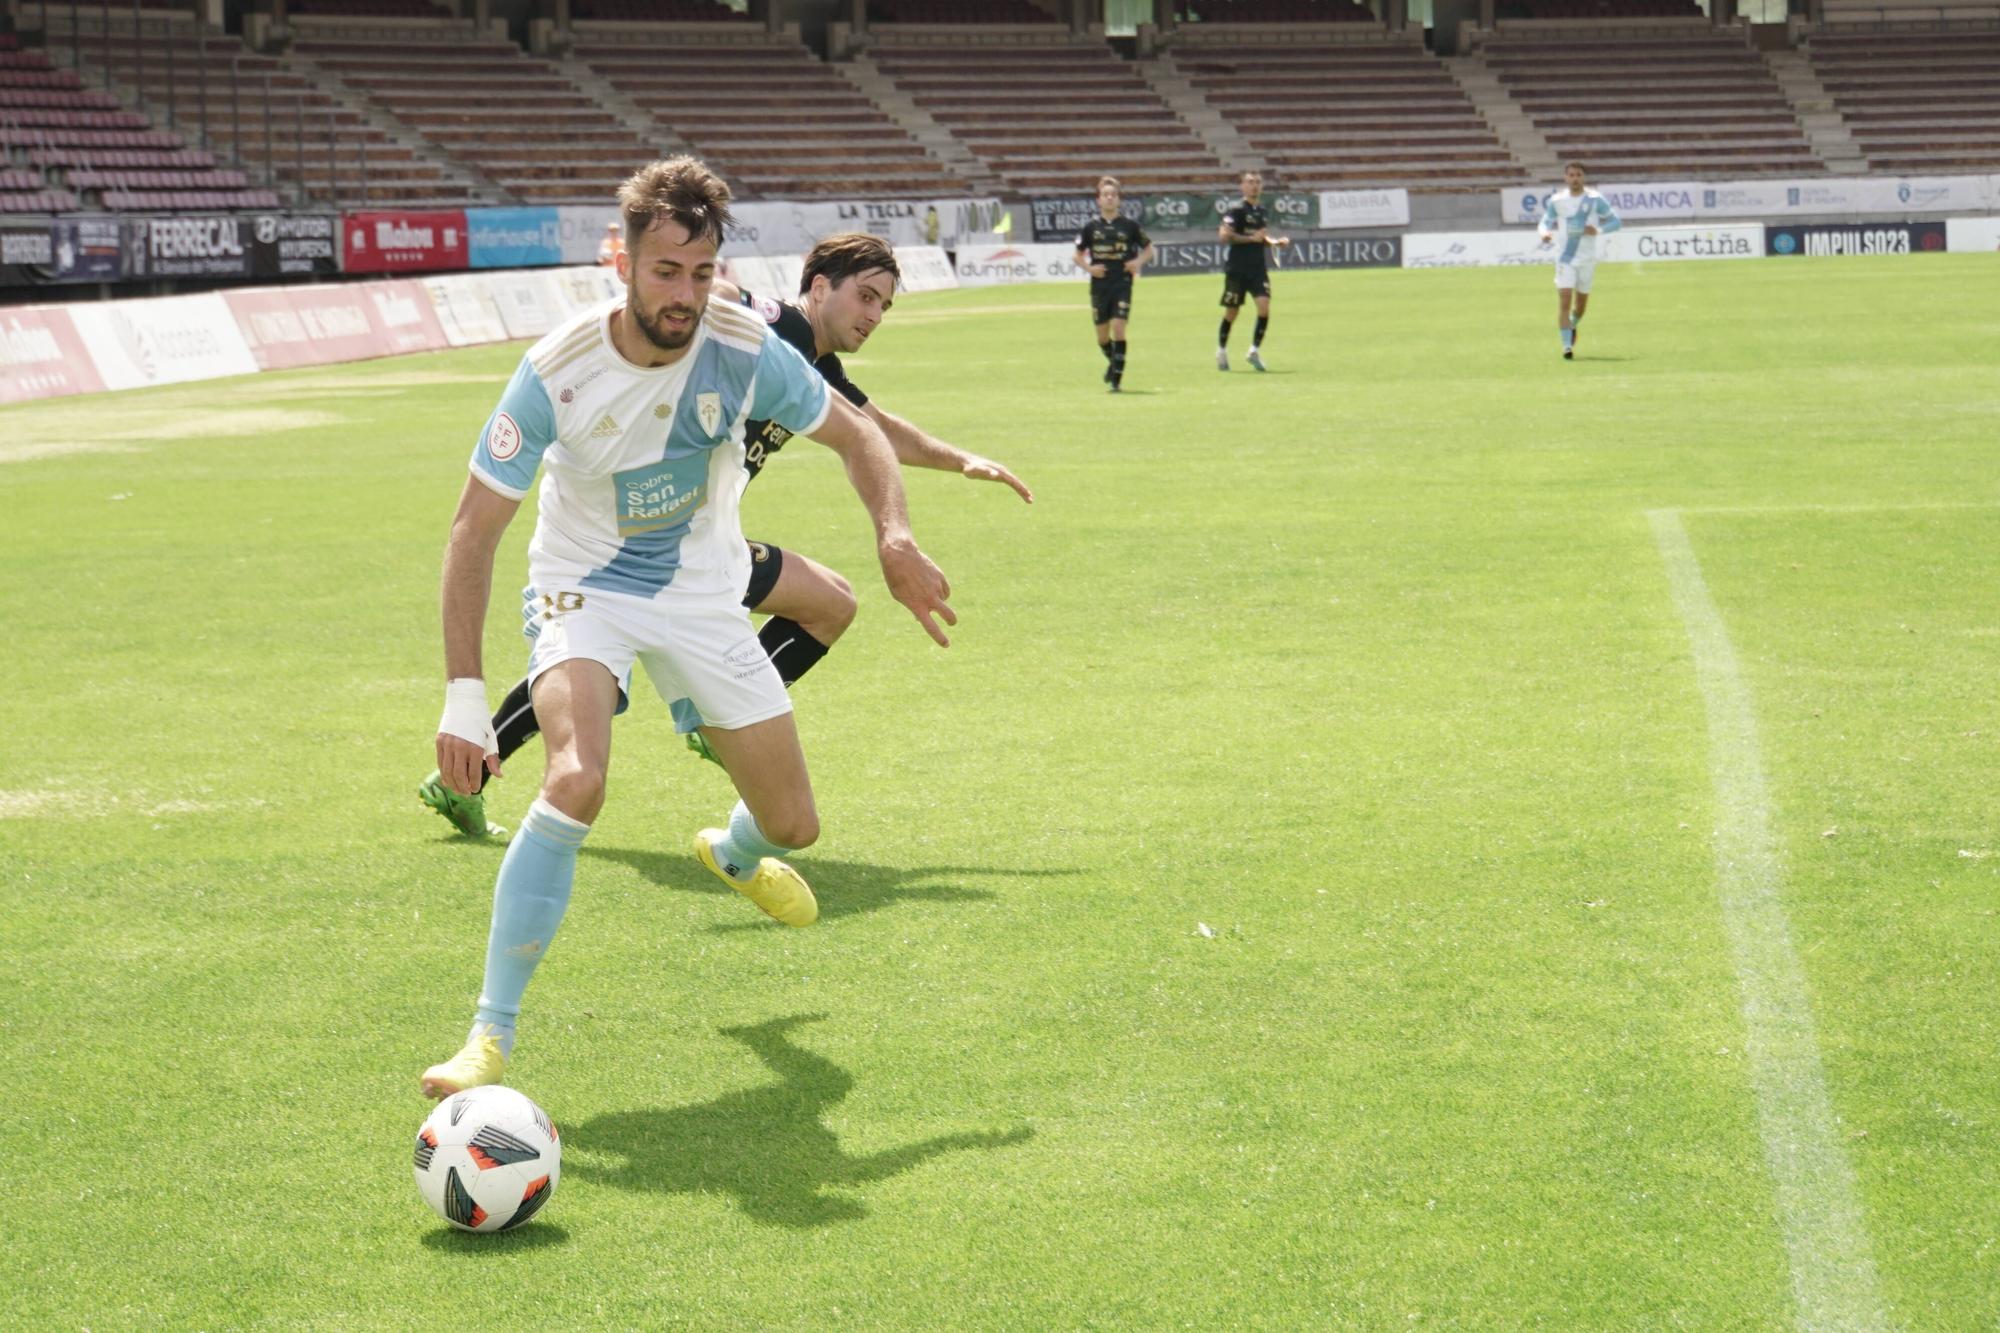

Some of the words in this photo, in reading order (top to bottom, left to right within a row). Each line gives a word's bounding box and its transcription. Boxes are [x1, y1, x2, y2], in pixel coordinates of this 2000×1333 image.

[838, 205, 858, 219] LA
[864, 203, 914, 218] TECLA
[1156, 197, 1190, 215] oca
[1274, 195, 1309, 214] oca
[1036, 214, 1052, 230] EL
[152, 218, 244, 258] FERRECAL
[1637, 232, 1753, 258] Curtiña
[1804, 229, 1910, 257] IMPULSO23
[1147, 244, 1231, 268] JESSI
[961, 260, 1037, 277] durmet
[627, 484, 675, 506] San
[628, 486, 698, 518] Rafael
